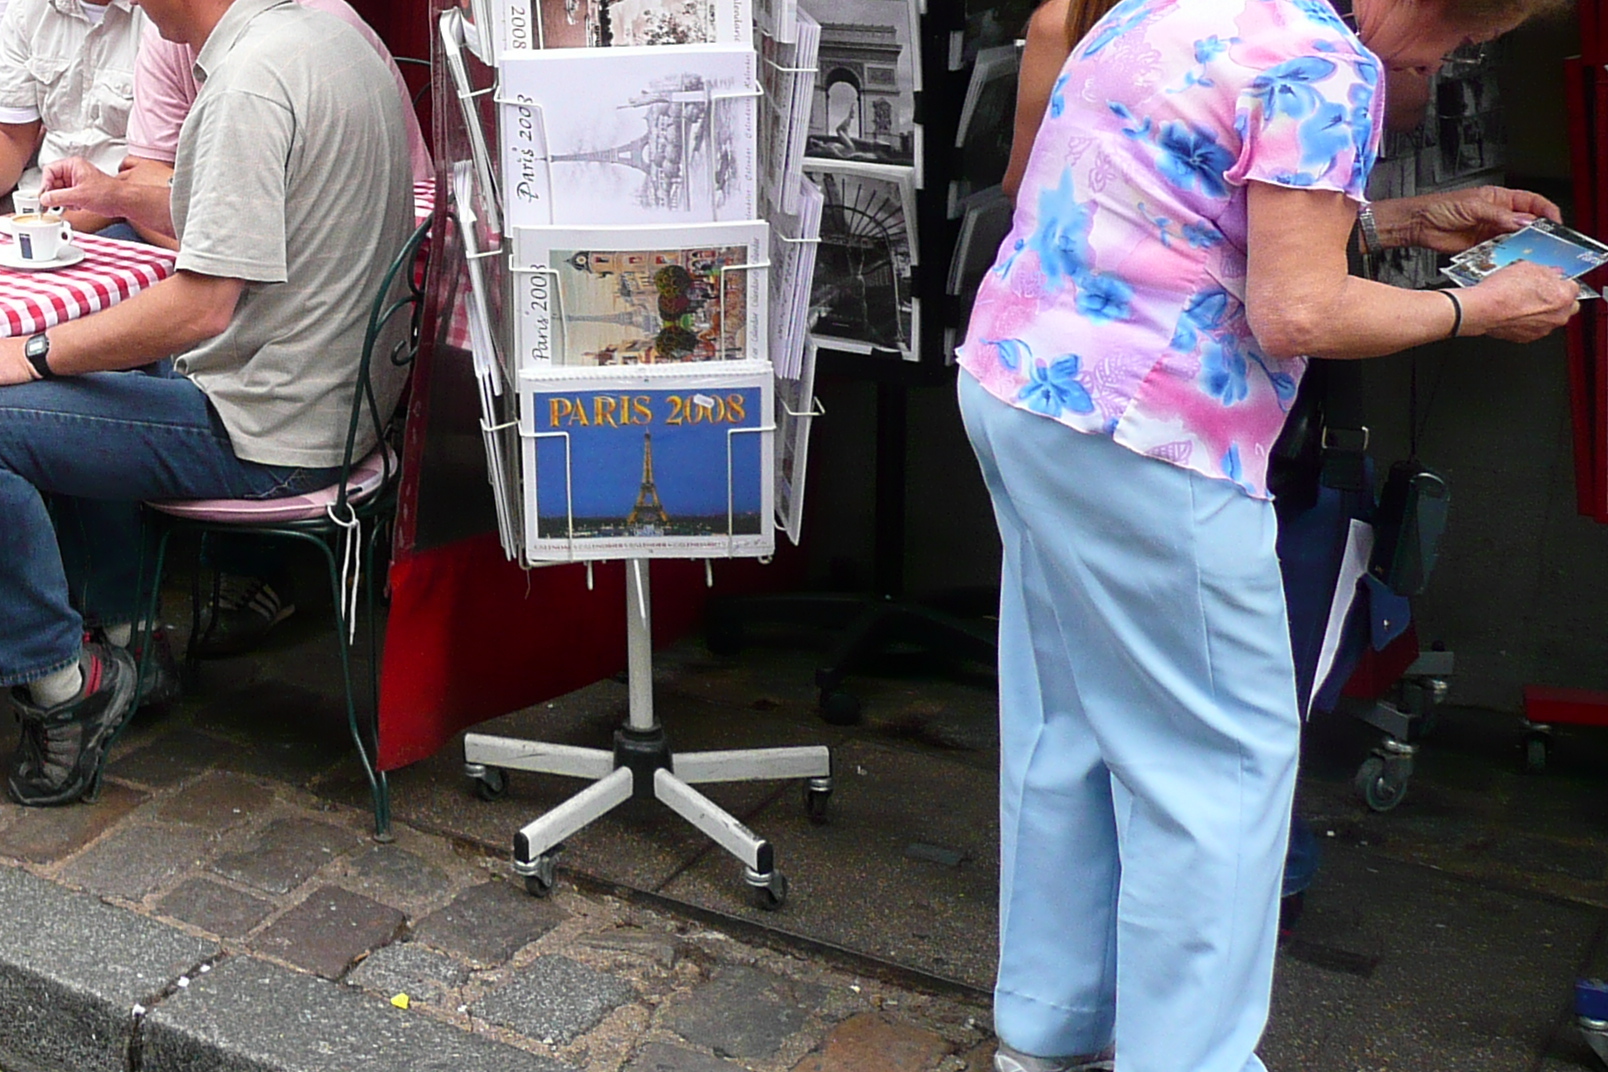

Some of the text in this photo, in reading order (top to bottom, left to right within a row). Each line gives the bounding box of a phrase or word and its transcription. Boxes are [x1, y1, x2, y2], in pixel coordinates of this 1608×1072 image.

[511, 6, 528, 50] 2008
[516, 147, 538, 203] Paris
[531, 316, 549, 360] Paris
[548, 392, 746, 428] PARIS 2008
